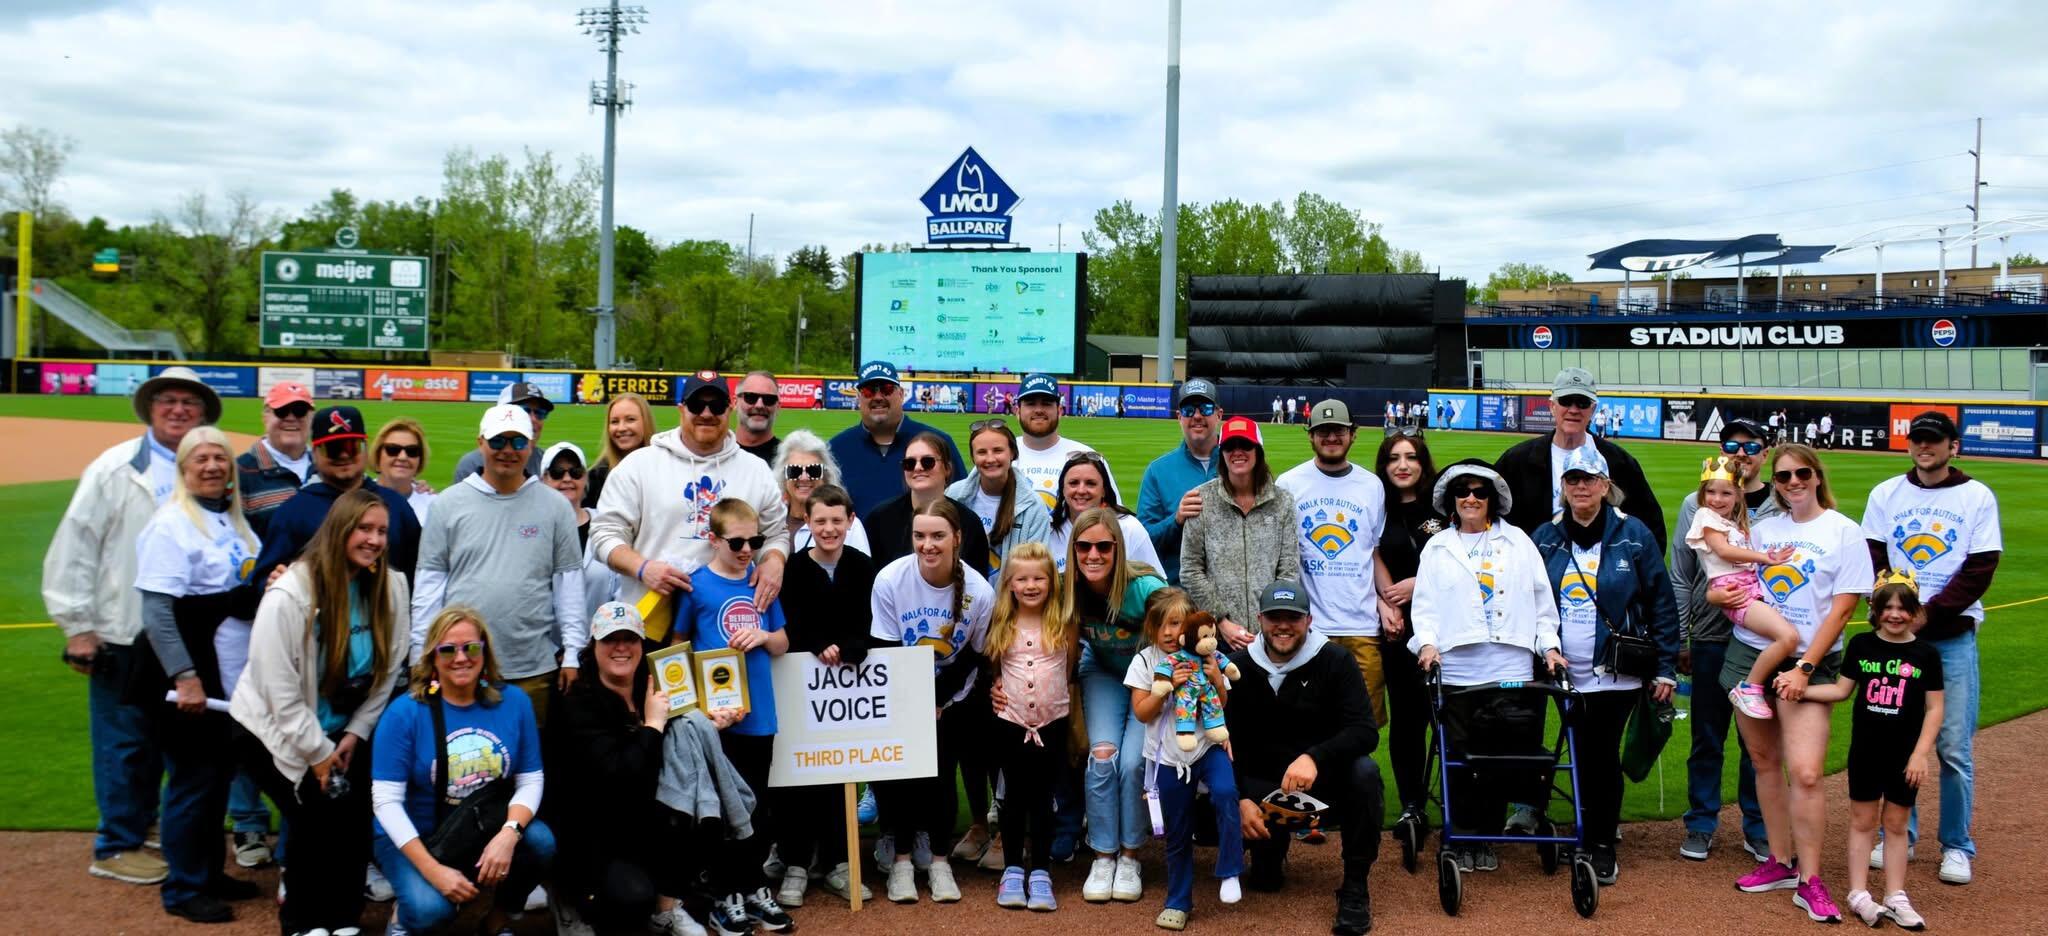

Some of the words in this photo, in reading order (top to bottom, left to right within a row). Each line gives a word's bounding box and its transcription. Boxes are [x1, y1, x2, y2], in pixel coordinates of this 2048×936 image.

[940, 193, 998, 212] LMCU
[929, 221, 1005, 235] BALLPARK
[315, 260, 375, 283] meijer
[1018, 266, 1062, 275] Sponsors!
[1629, 326, 1763, 345] STADIUM
[1767, 325, 1845, 345] CLUB
[608, 378, 669, 393] FERRIS
[1026, 467, 1041, 475] FOR
[1298, 500, 1319, 512] WALK
[1320, 498, 1334, 506] FOR
[1336, 499, 1363, 516] AUTISM
[1893, 509, 1914, 522] WALK
[1916, 508, 1932, 516] FOR
[1933, 508, 1964, 525] AUTISM
[1798, 541, 1826, 555] AUTISM
[728, 614, 756, 622] DETROIT
[901, 607, 922, 623] WALK
[923, 607, 940, 617] FOR
[808, 664, 888, 691] JACKS
[1858, 659, 1881, 673] You
[1886, 658, 1922, 679] Glow
[1866, 676, 1906, 707] Girl
[811, 695, 887, 722] VOICE
[794, 749, 844, 768] THIRD
[849, 745, 904, 764] PLACE
